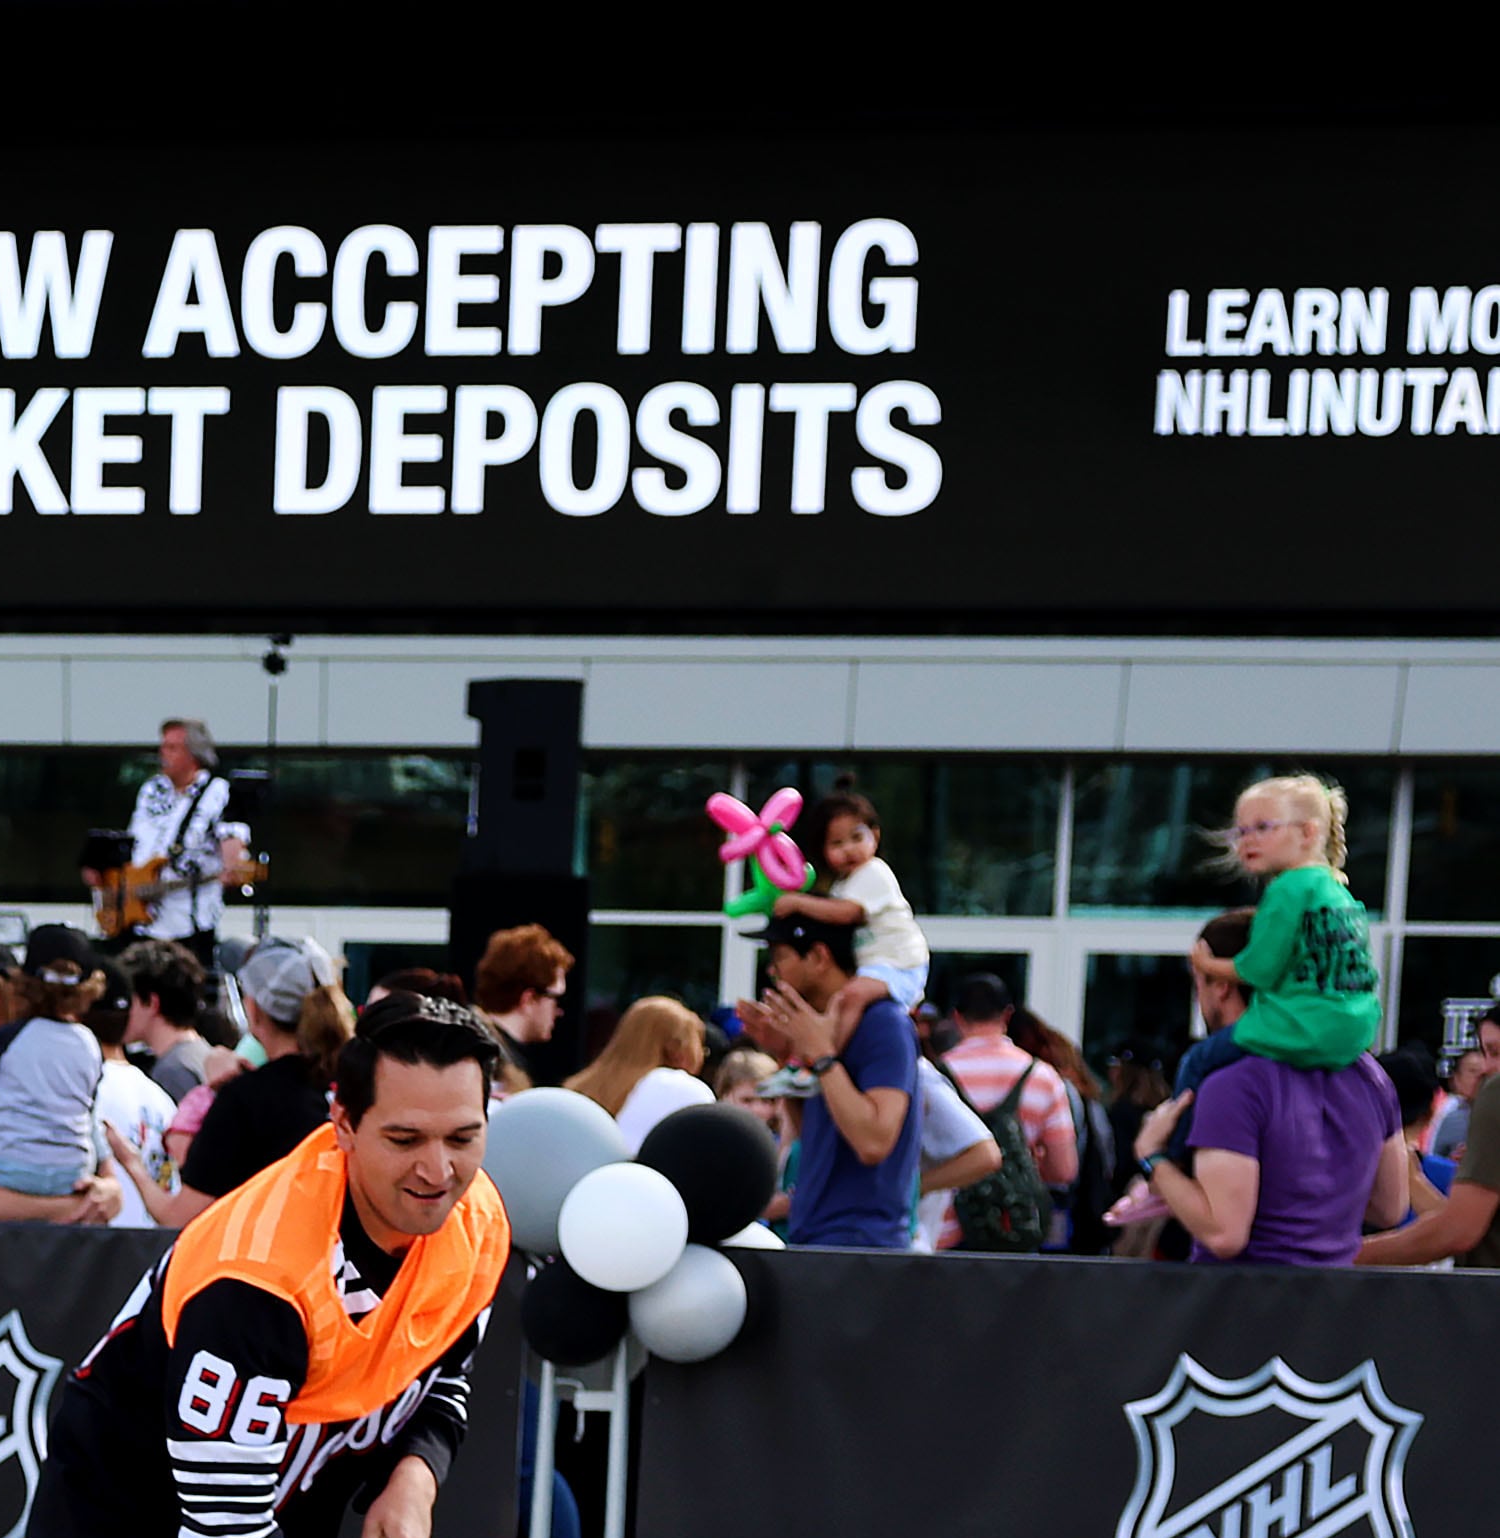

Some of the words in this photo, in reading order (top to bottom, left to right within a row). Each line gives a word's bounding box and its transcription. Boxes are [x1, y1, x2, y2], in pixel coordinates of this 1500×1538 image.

[141, 217, 919, 360] ACCEPTING
[1165, 286, 1390, 357] LEARN
[272, 379, 943, 517] DEPOSITS
[178, 1350, 292, 1447] 86
